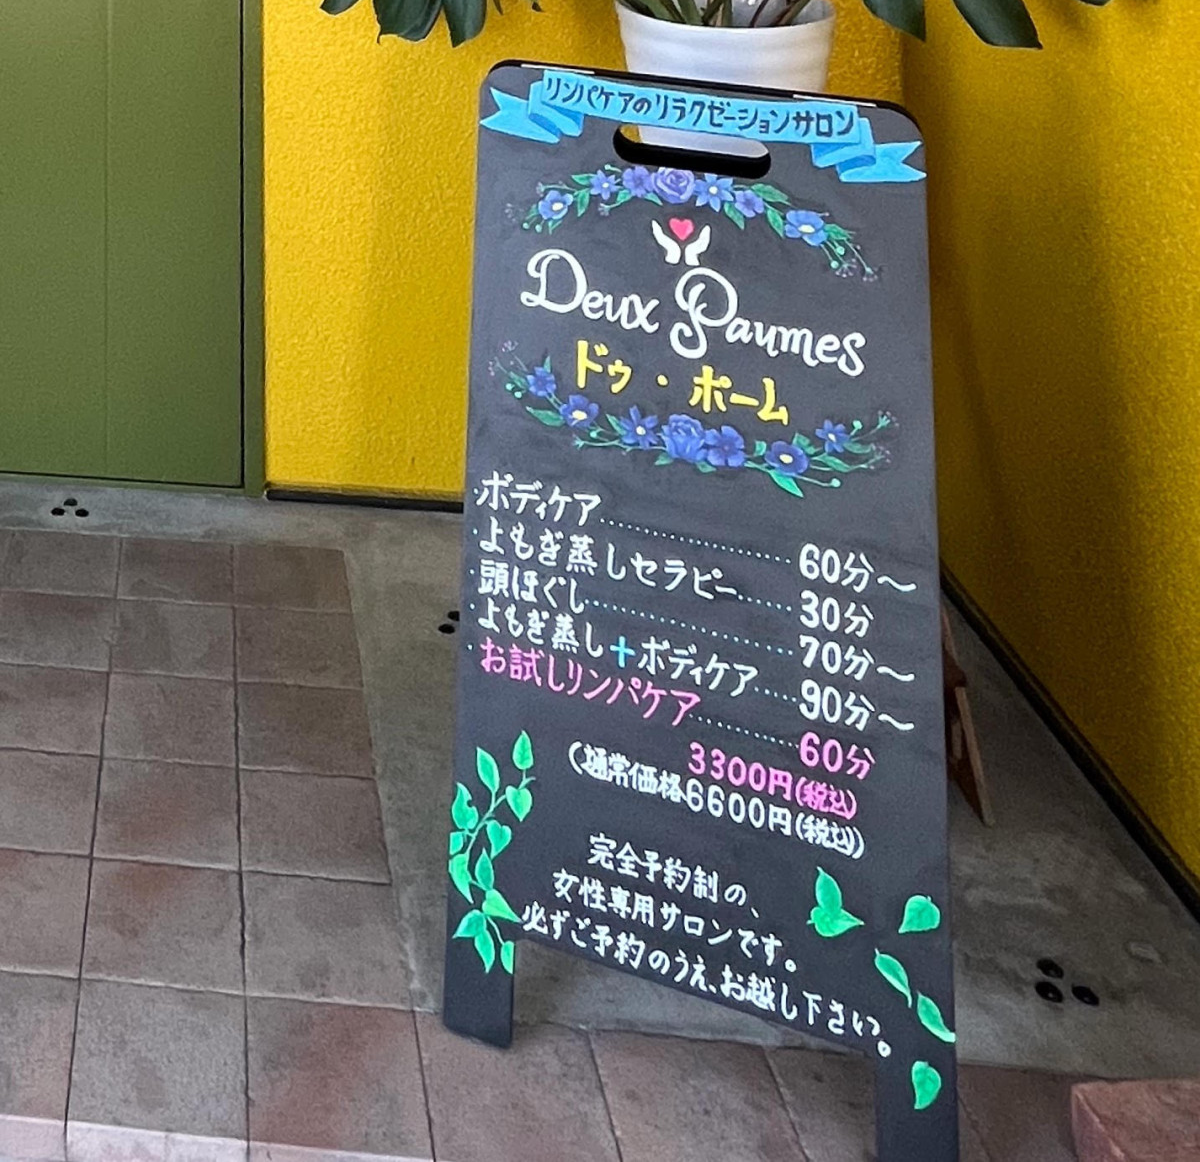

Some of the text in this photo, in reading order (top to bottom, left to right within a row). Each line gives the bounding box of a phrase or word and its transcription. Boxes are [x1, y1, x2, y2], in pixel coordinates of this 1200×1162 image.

[546, 78, 855, 138] リンパケアのリラクゼーションサロン
[519, 248, 866, 377] Deux Paumes
[799, 591, 874, 639] 30分
[800, 732, 876, 780] 60分
[552, 868, 798, 973] 女性専用サロンです。
